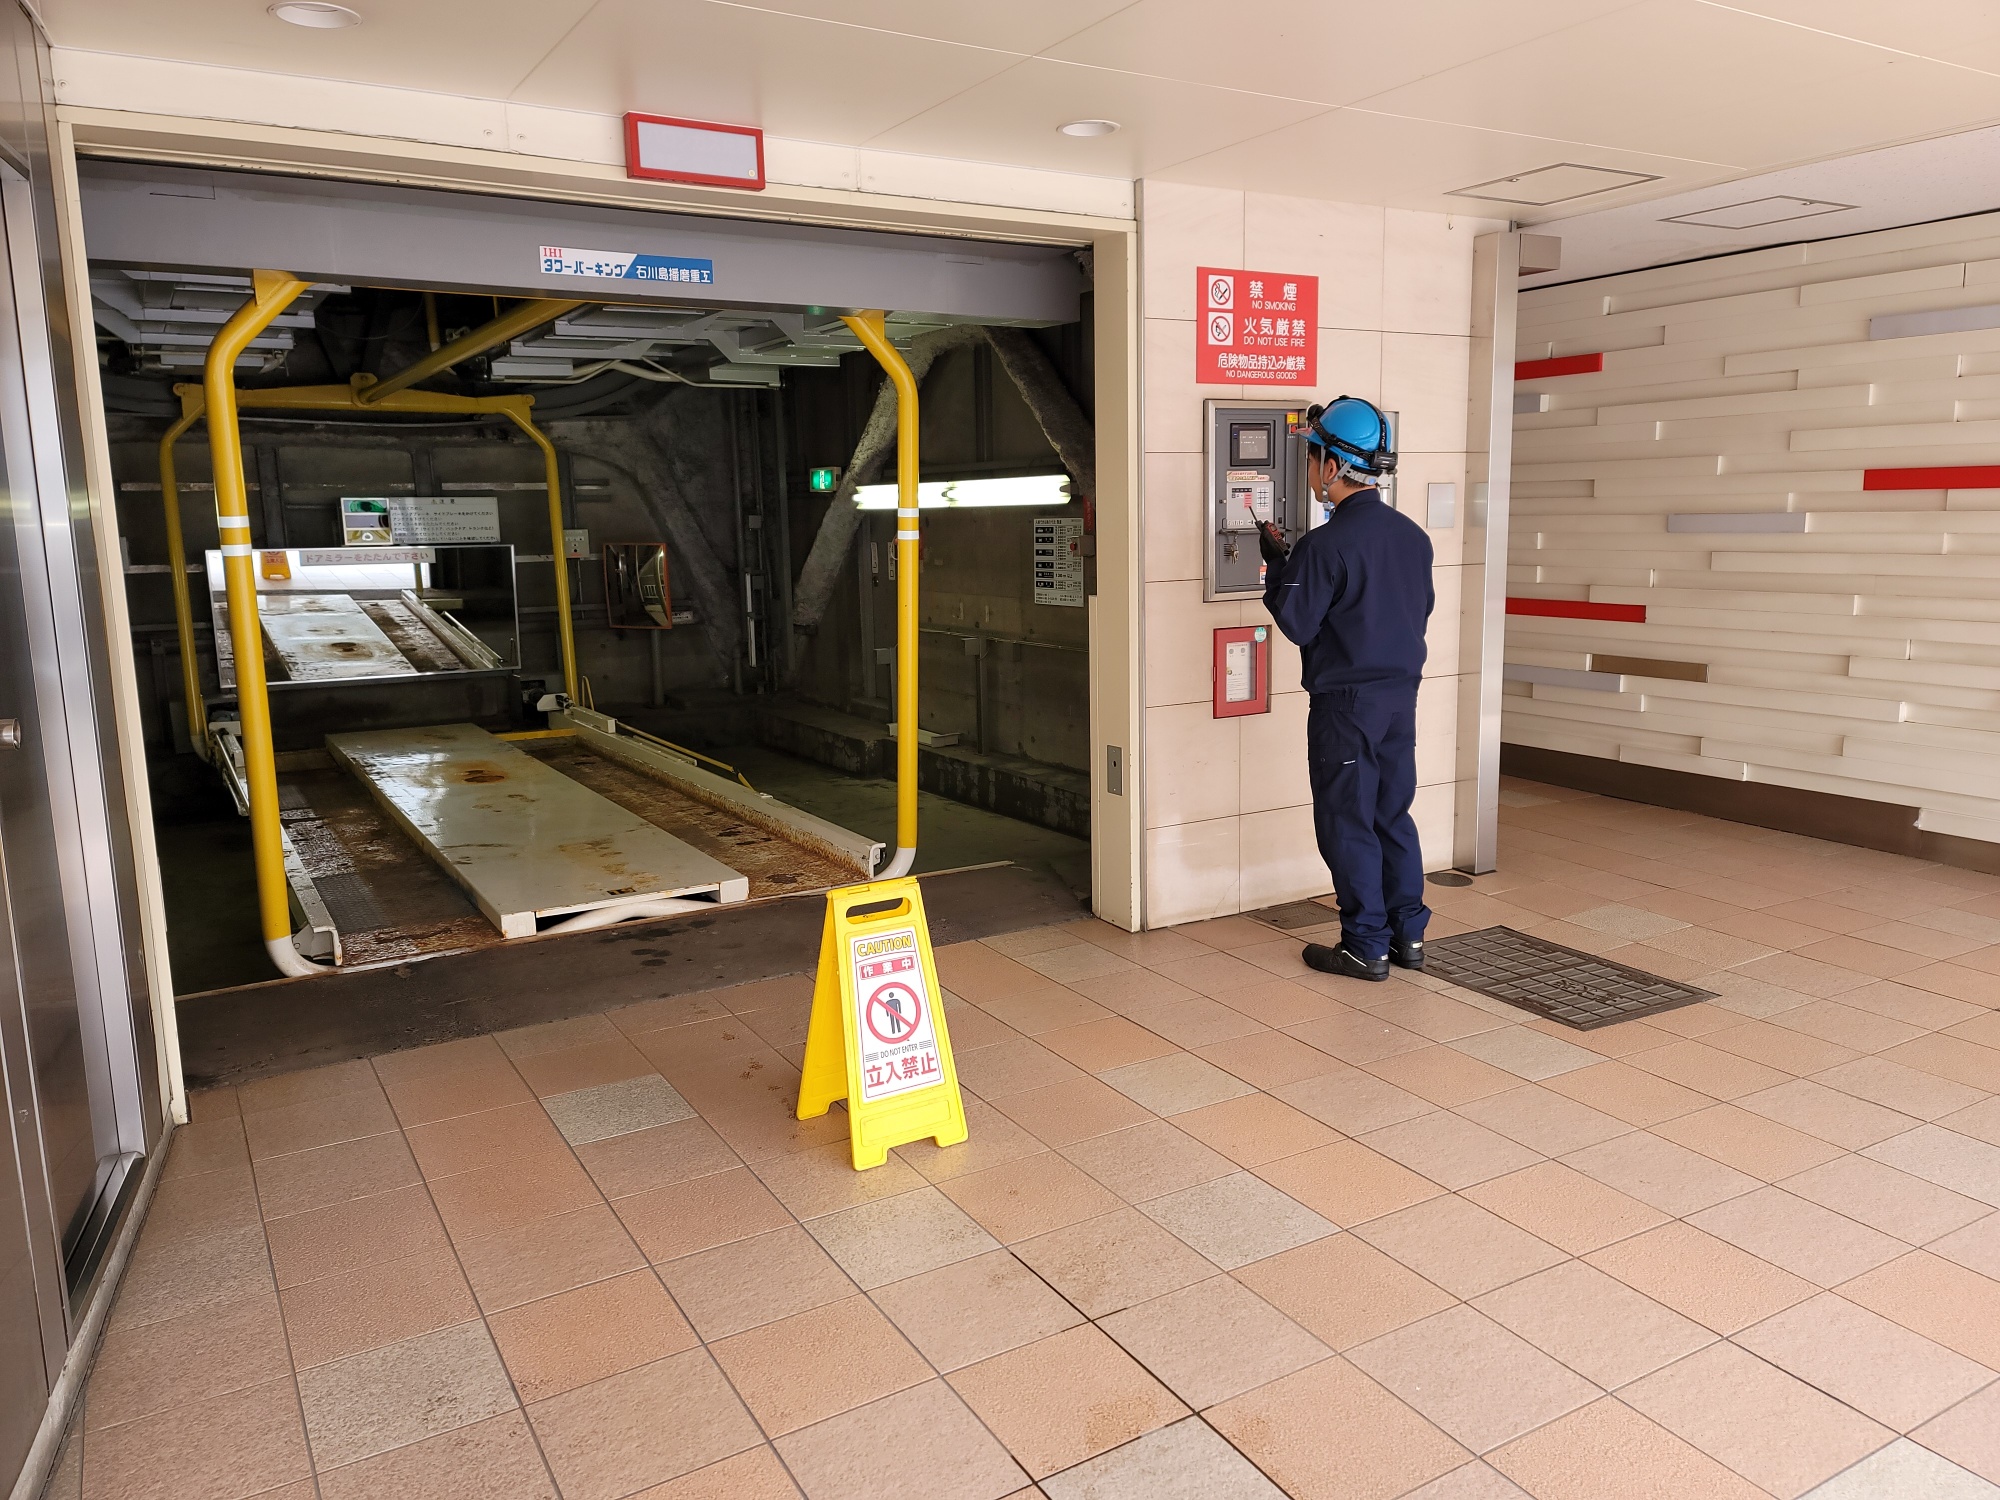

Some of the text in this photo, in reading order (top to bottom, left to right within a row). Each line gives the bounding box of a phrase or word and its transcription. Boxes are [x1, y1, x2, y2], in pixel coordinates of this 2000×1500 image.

[543, 247, 563, 259] IHI
[544, 258, 627, 277] タワーパーキング
[636, 265, 711, 284] 石川島播磨重工
[1249, 280, 1297, 301] 禁煙
[1252, 300, 1296, 311] NO SMOKING
[1243, 317, 1306, 337] 火気厳禁
[1244, 336, 1305, 347] DO NOT USE FIRE
[1217, 352, 1306, 370] 危険物品持込み厳禁
[1237, 370, 1275, 379] DANGEROUS
[1276, 371, 1297, 379] GOODS
[305, 551, 429, 563] ドアミラーをたたんで下さい
[856, 934, 913, 957] CAUTION
[862, 958, 913, 978] 作業中
[880, 1043, 919, 1059] DO NOT ENTER
[866, 1052, 938, 1088] 立入禁止
